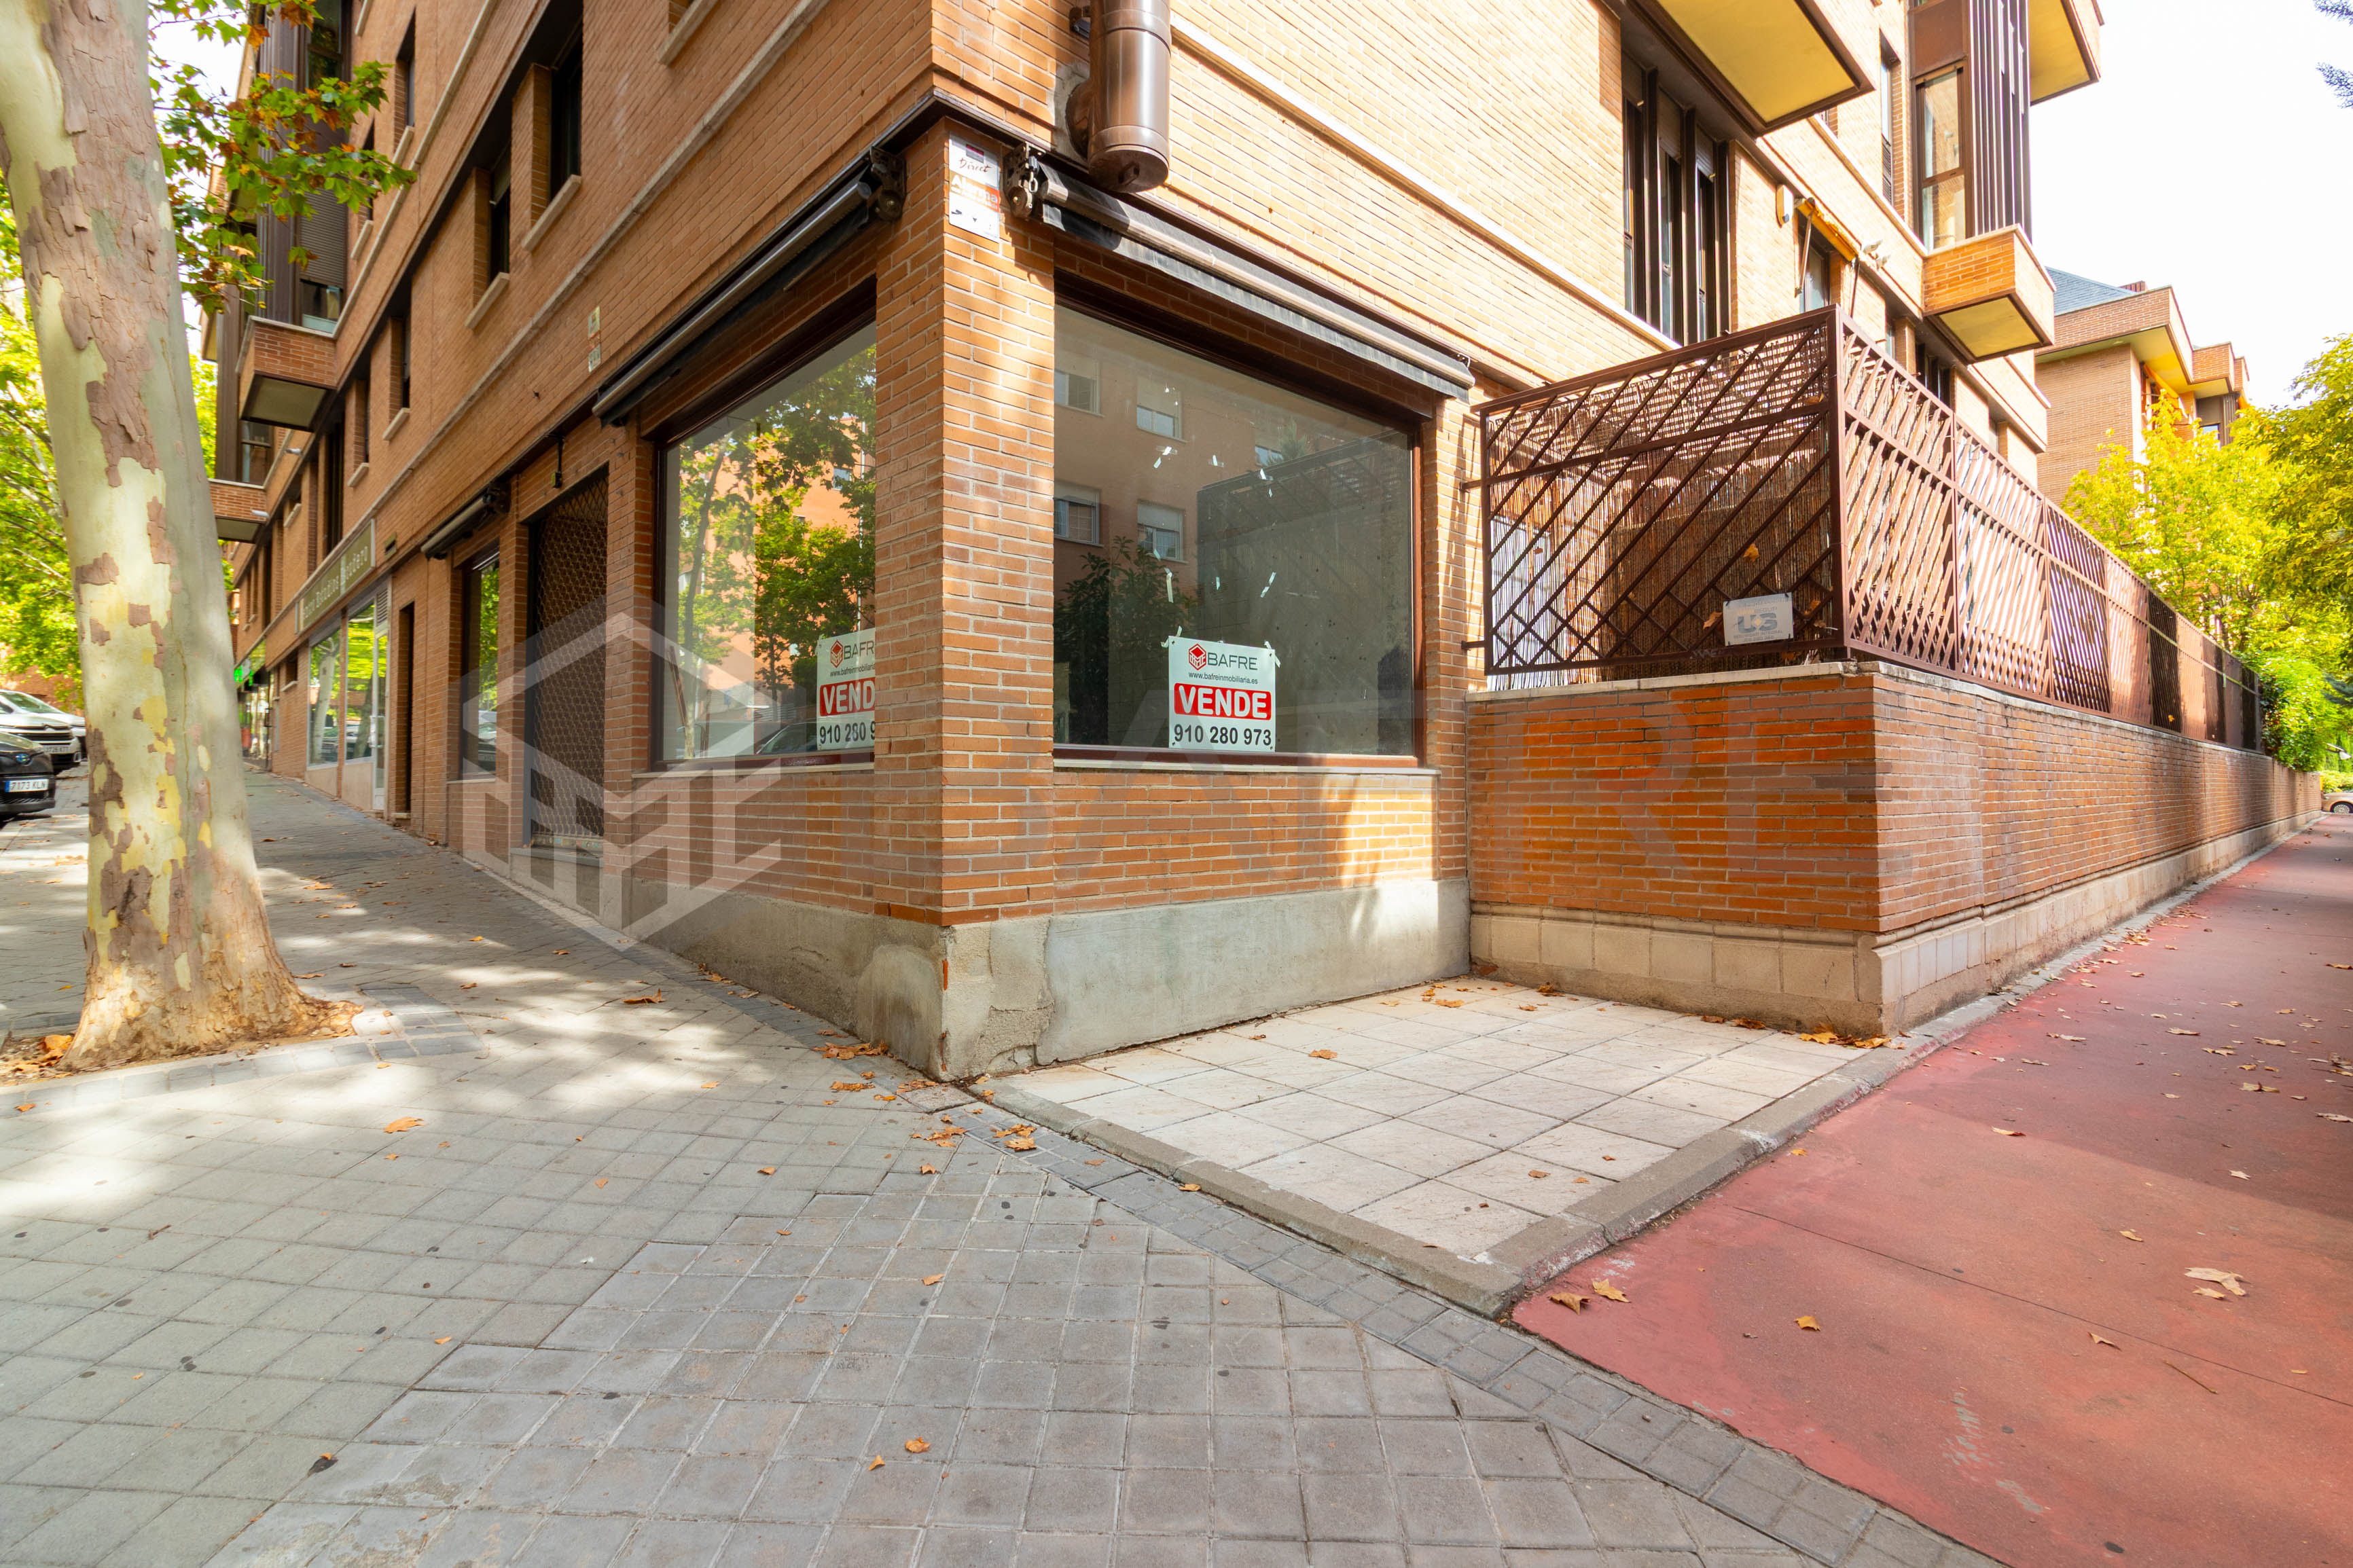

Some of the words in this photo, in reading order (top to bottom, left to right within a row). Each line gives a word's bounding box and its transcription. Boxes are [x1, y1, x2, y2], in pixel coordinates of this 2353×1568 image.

[958, 158, 992, 172] Direct
[844, 640, 875, 659] BAFR
[830, 663, 875, 676] www.bafreinmobiliaria
[1208, 652, 1258, 670] BAFRE
[1189, 672, 1258, 685] www.bafreinmobiliaria.es
[823, 680, 875, 714] VEND
[1179, 685, 1268, 718] VENDE
[819, 725, 840, 744] 910
[844, 722, 866, 742] 280
[1174, 724, 1204, 743] 910
[1210, 726, 1238, 744] 280
[1244, 728, 1272, 746] 973
